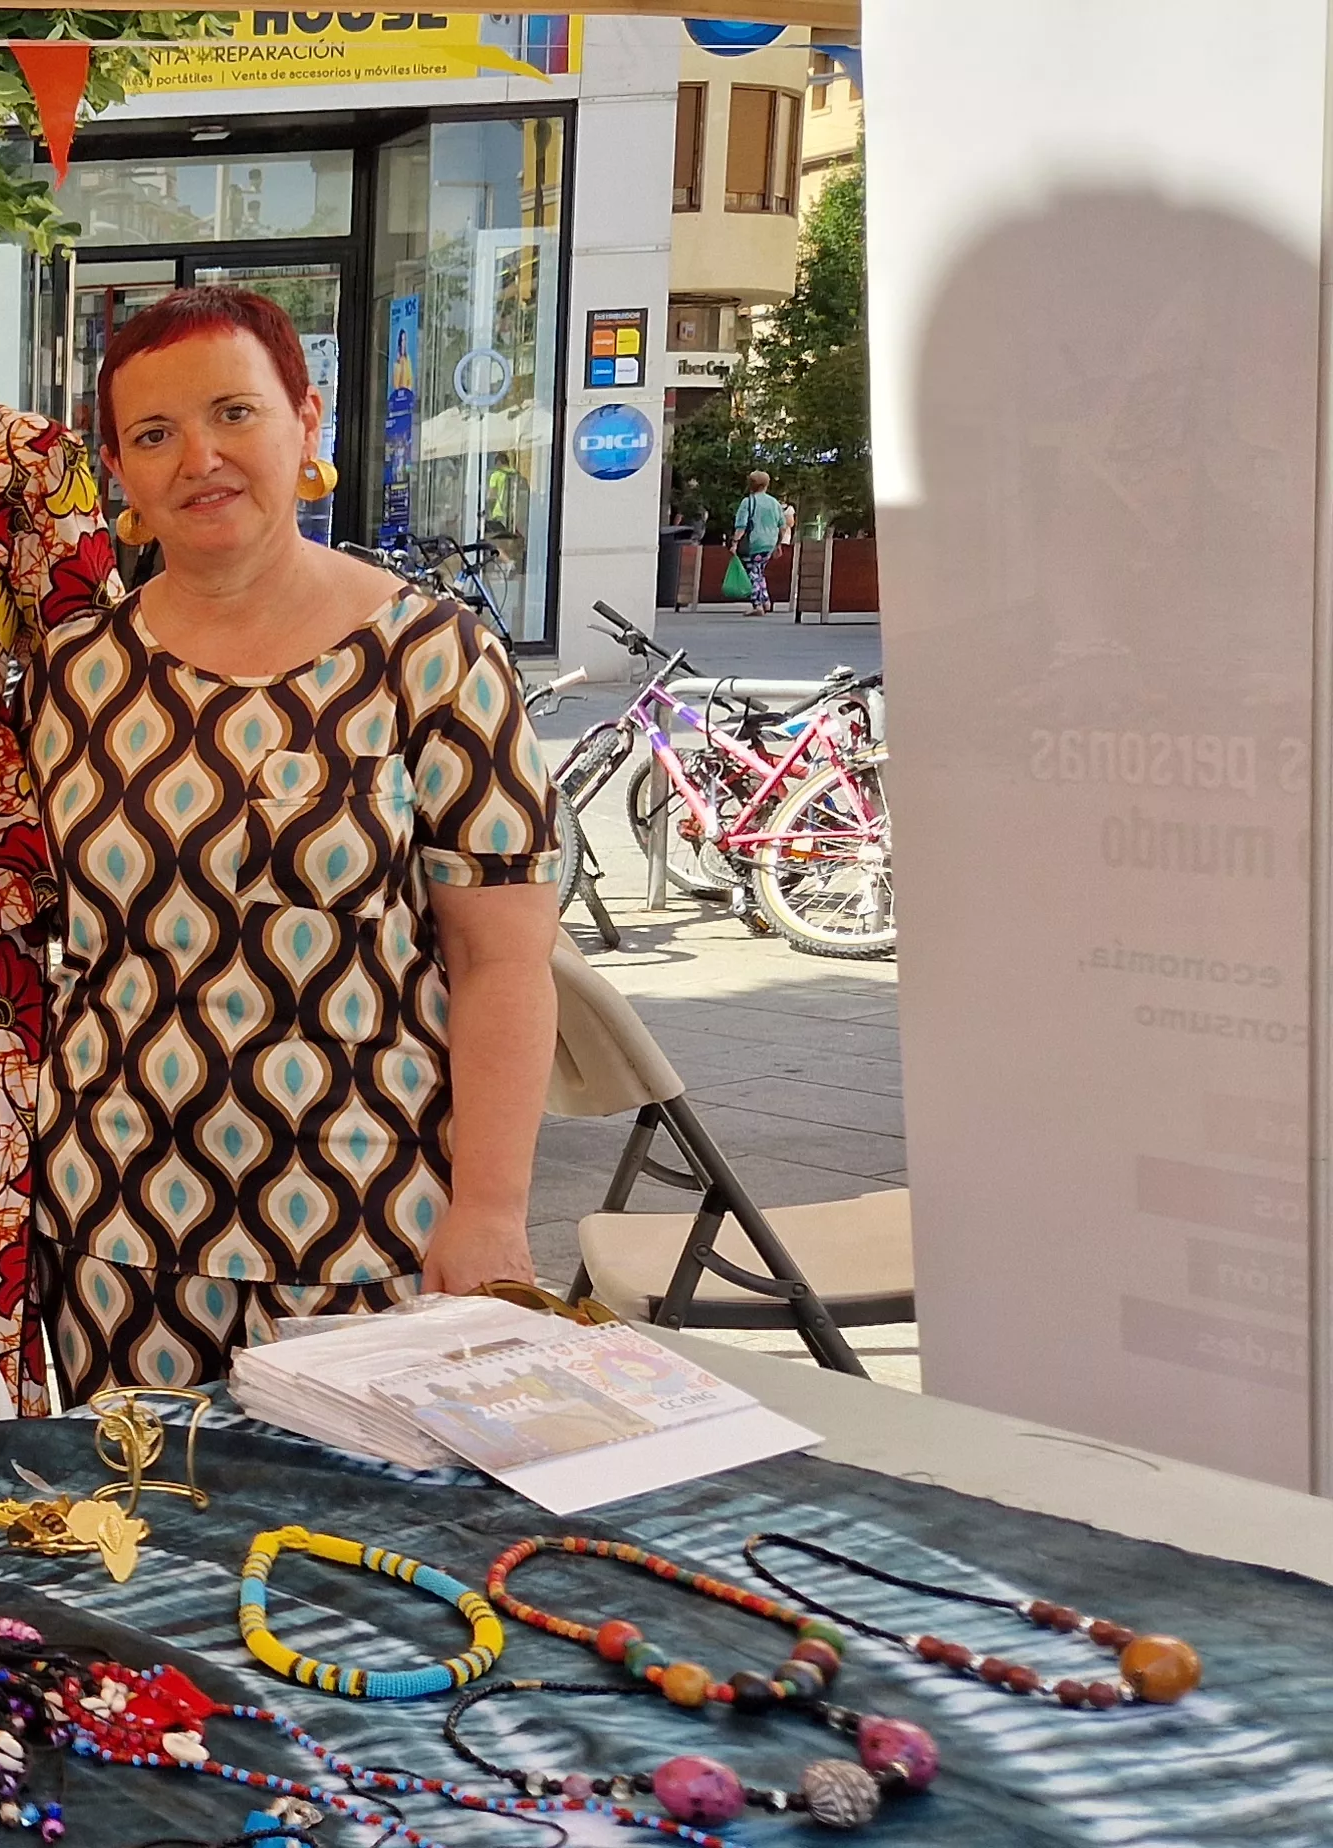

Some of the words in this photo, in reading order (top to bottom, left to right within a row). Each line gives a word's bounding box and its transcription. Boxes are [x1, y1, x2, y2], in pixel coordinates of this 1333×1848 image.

[156, 72, 213, 87] portátiles
[231, 70, 267, 82] Venta
[271, 68, 285, 80] de
[289, 66, 351, 80] accesorios
[354, 69, 361, 80] y
[364, 65, 410, 77] móviles
[413, 63, 447, 75] libres
[580, 432, 648, 450] DIGI
